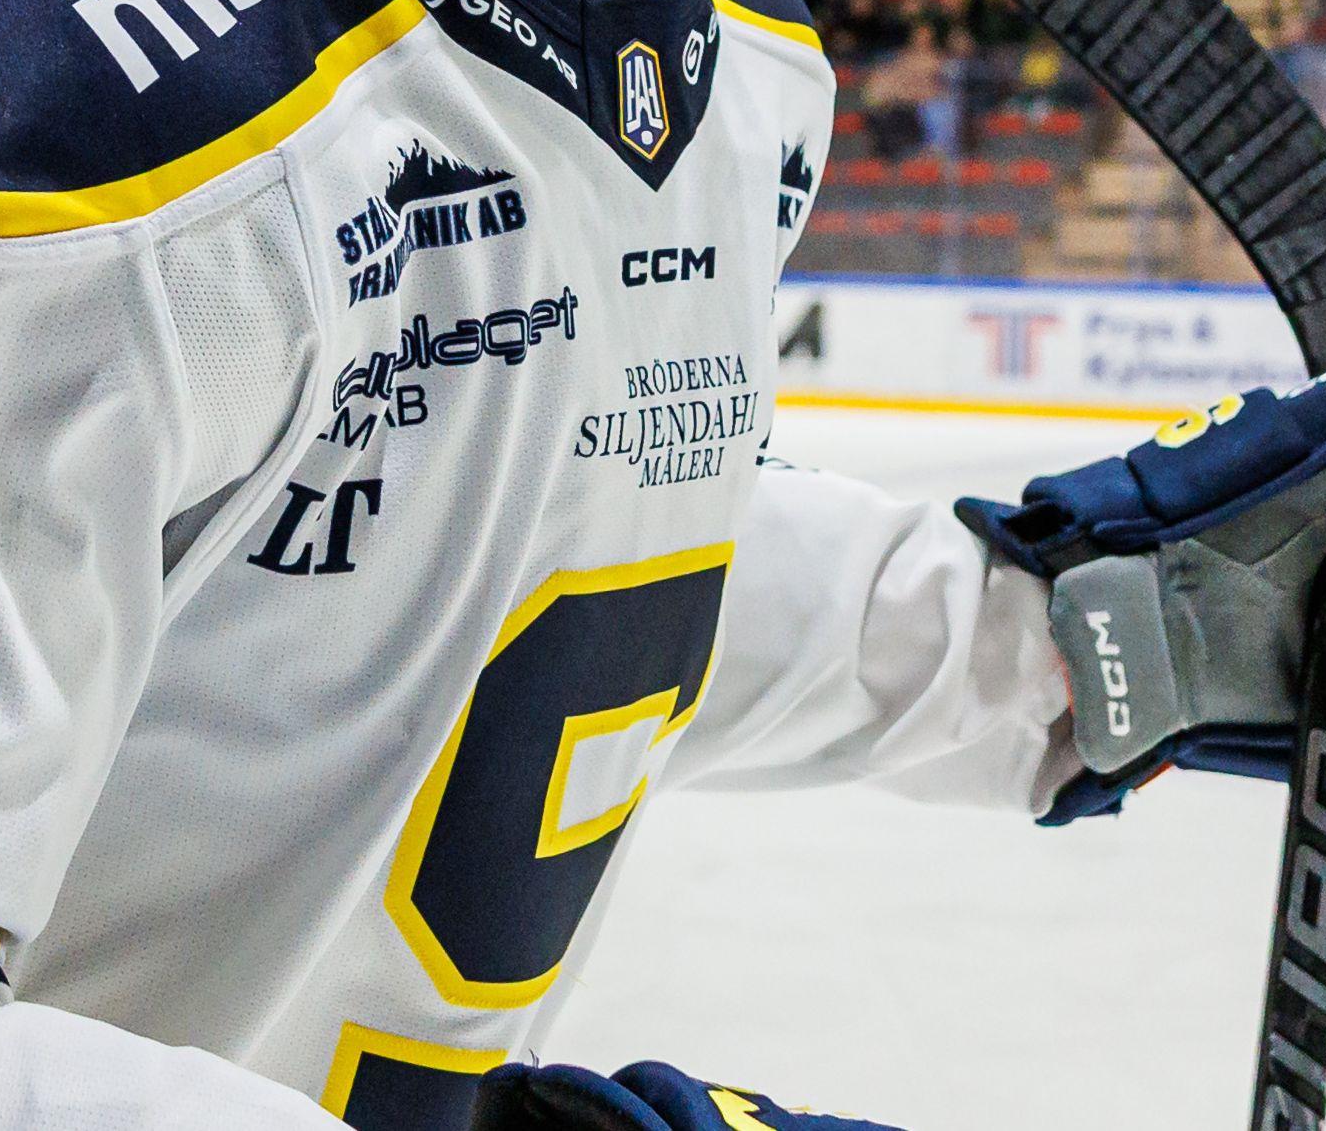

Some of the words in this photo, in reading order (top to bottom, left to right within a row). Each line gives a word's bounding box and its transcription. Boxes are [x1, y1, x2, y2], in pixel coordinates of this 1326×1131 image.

[479, 189, 527, 239] AB
[621, 246, 716, 288] CCM
[625, 354, 747, 400] BRÖDERNA
[638, 447, 725, 489] MÅLERI
[247, 478, 383, 577] LT
[1084, 610, 1131, 737] CCM
